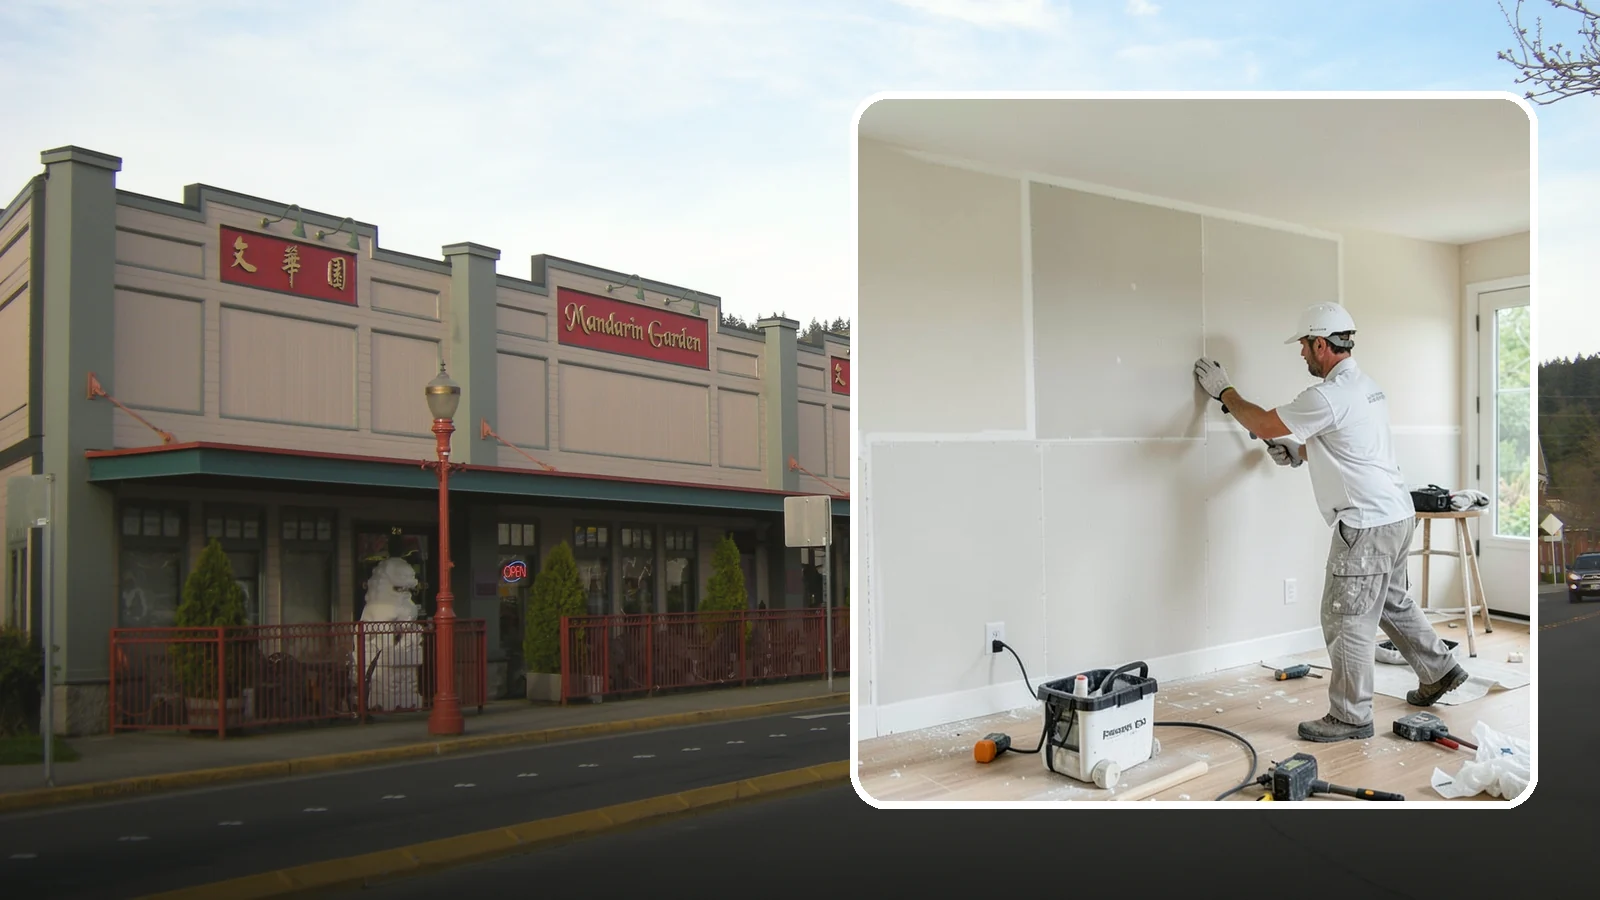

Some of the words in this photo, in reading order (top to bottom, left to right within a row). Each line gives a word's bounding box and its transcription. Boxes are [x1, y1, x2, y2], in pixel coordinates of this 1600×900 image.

[564, 302, 644, 341] Mandarin
[648, 320, 702, 352] Garden
[834, 363, 846, 386] 文
[503, 565, 527, 578] OPEN
